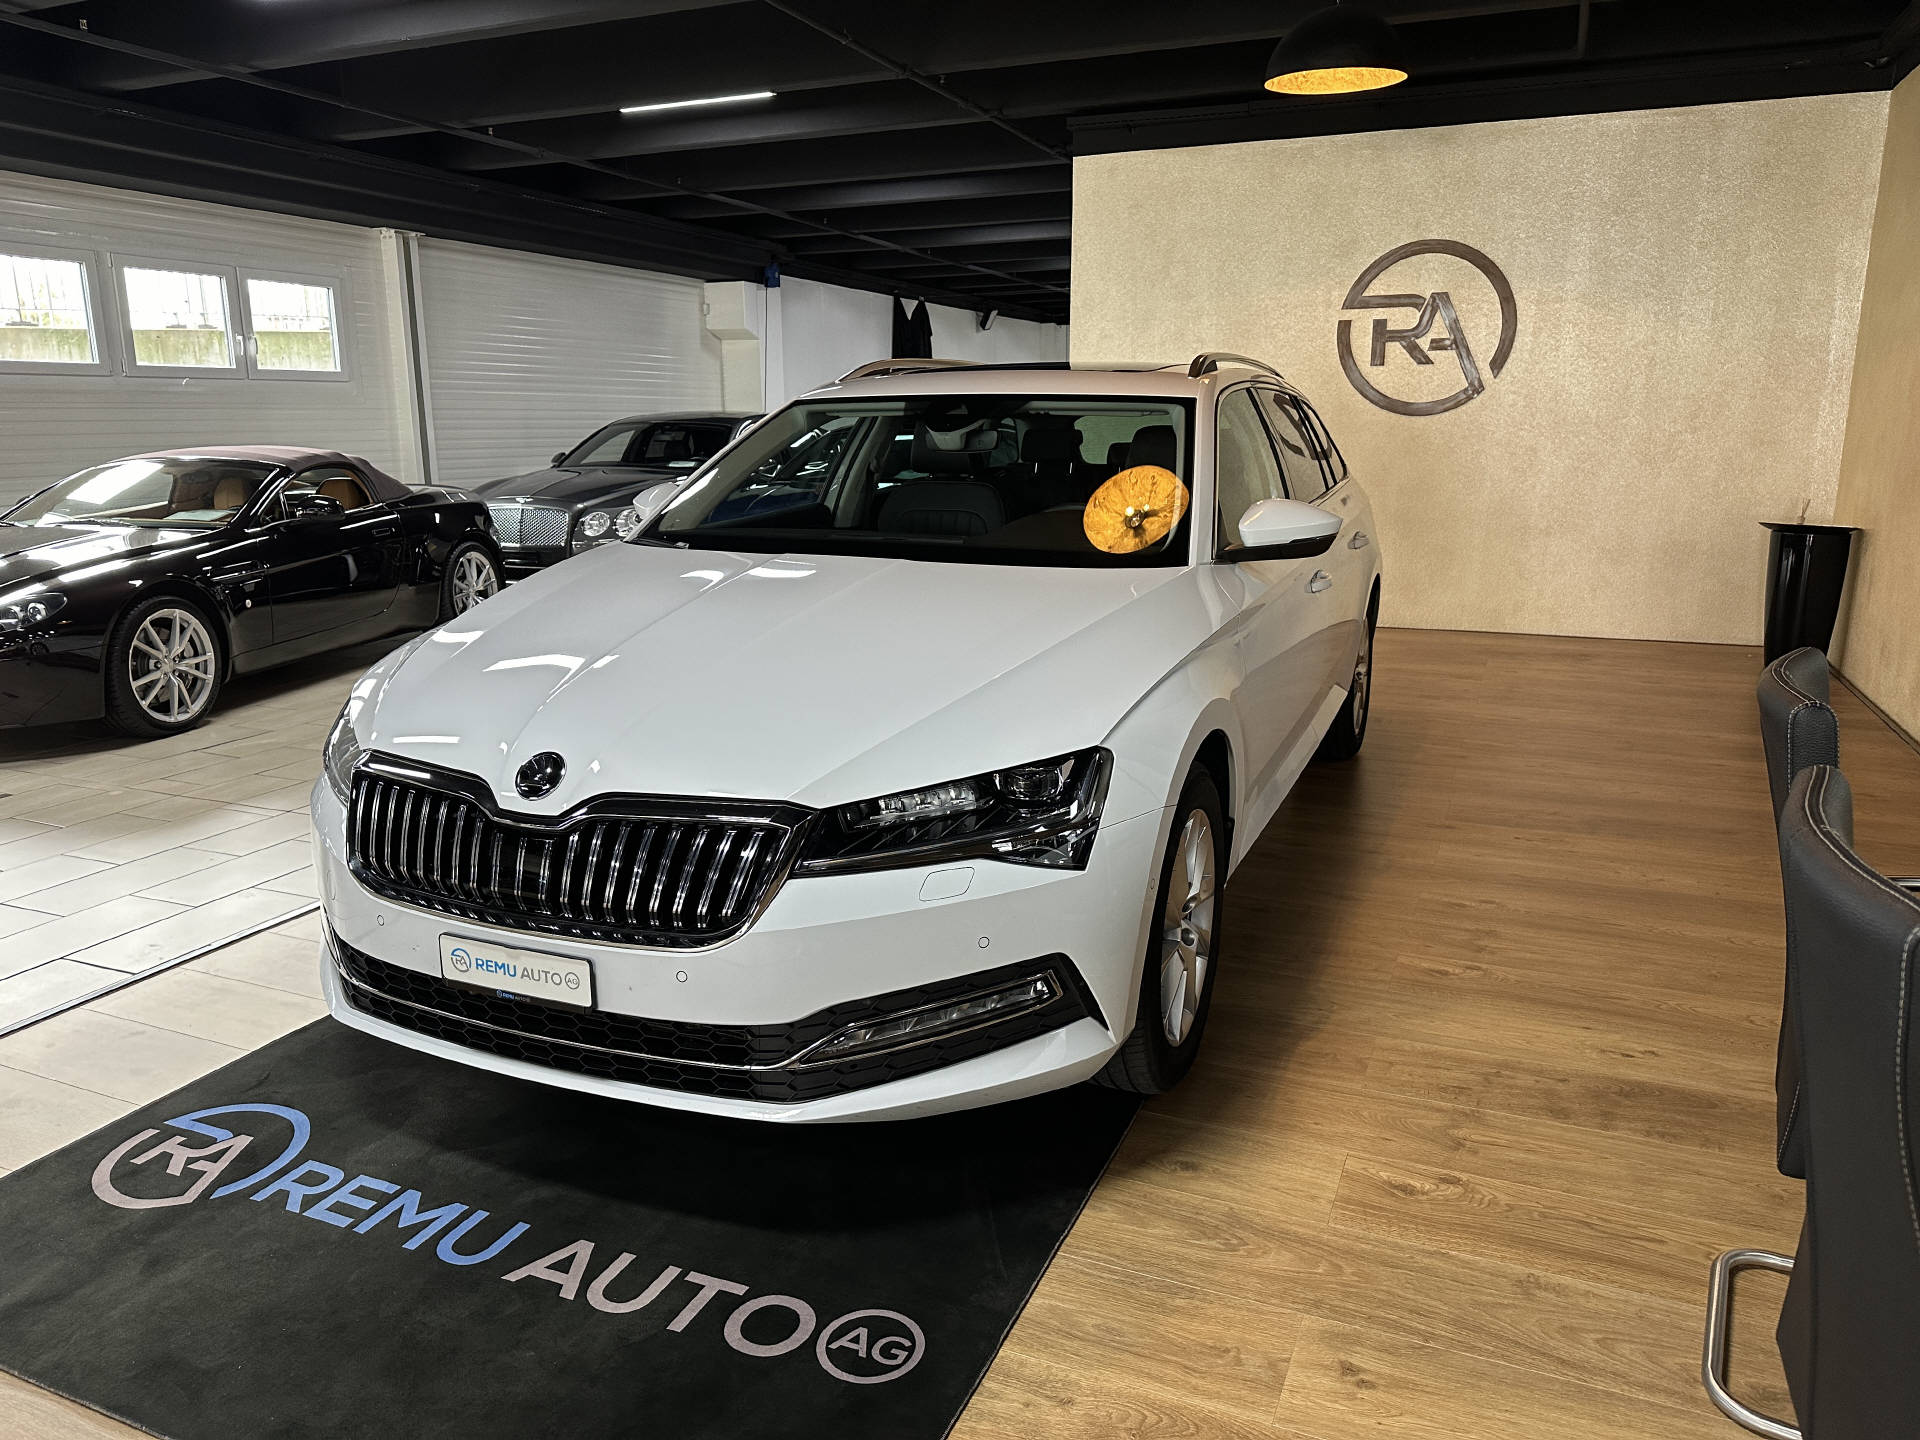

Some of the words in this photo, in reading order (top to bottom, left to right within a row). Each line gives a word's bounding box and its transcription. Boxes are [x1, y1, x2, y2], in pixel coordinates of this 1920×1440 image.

[475, 957, 517, 978] REMU
[520, 966, 562, 986] AUTO
[249, 1159, 531, 1265] REMU
[501, 1239, 816, 1357] AUTO
[828, 1326, 912, 1366] AG
